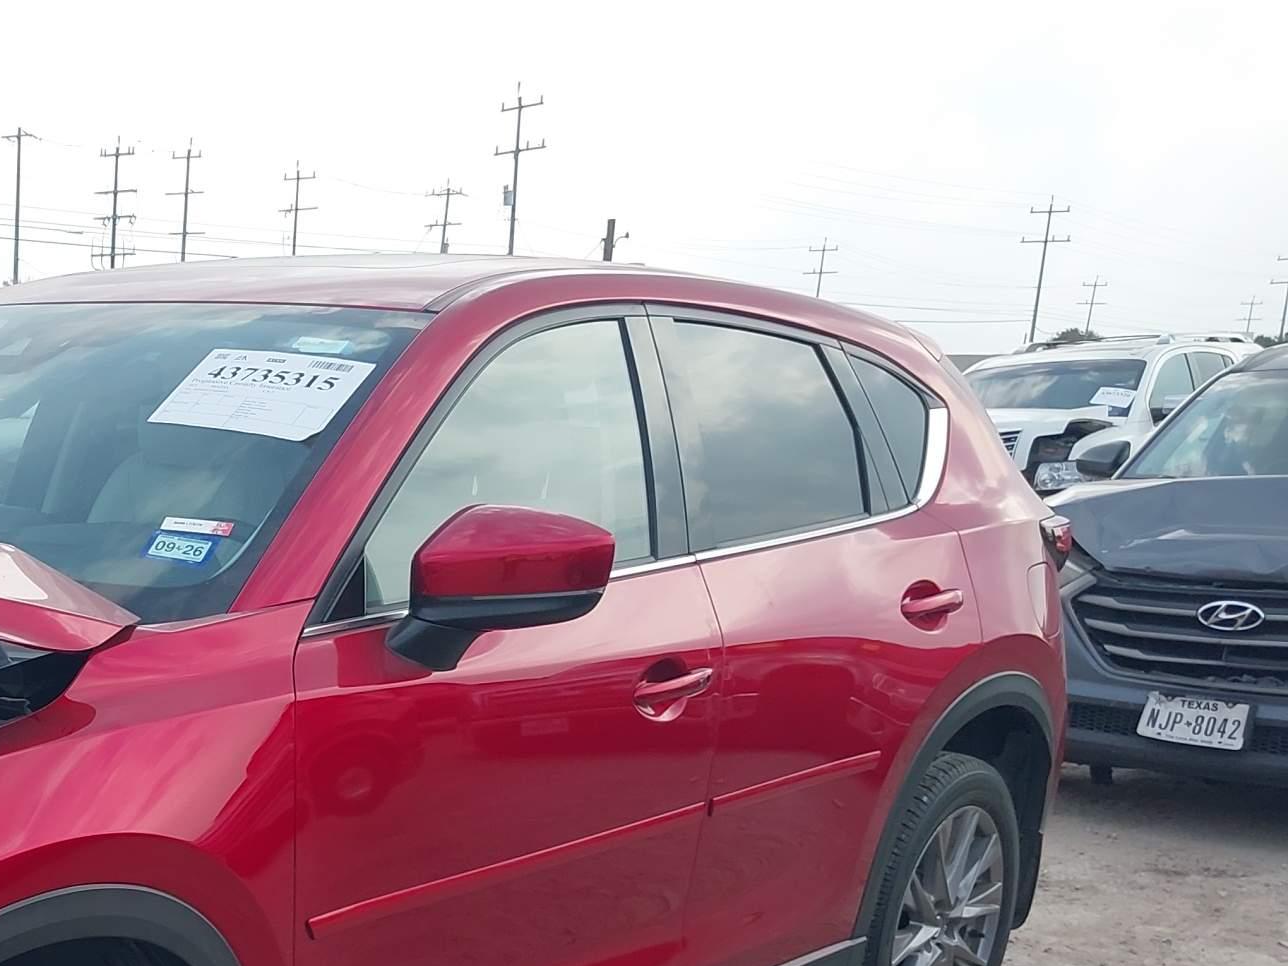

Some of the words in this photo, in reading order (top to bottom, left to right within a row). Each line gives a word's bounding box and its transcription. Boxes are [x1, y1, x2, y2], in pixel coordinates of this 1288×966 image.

[207, 365, 341, 391] 43735315
[155, 540, 176, 552] 09
[182, 544, 205, 557] 26
[1181, 700, 1219, 711] TEXAS
